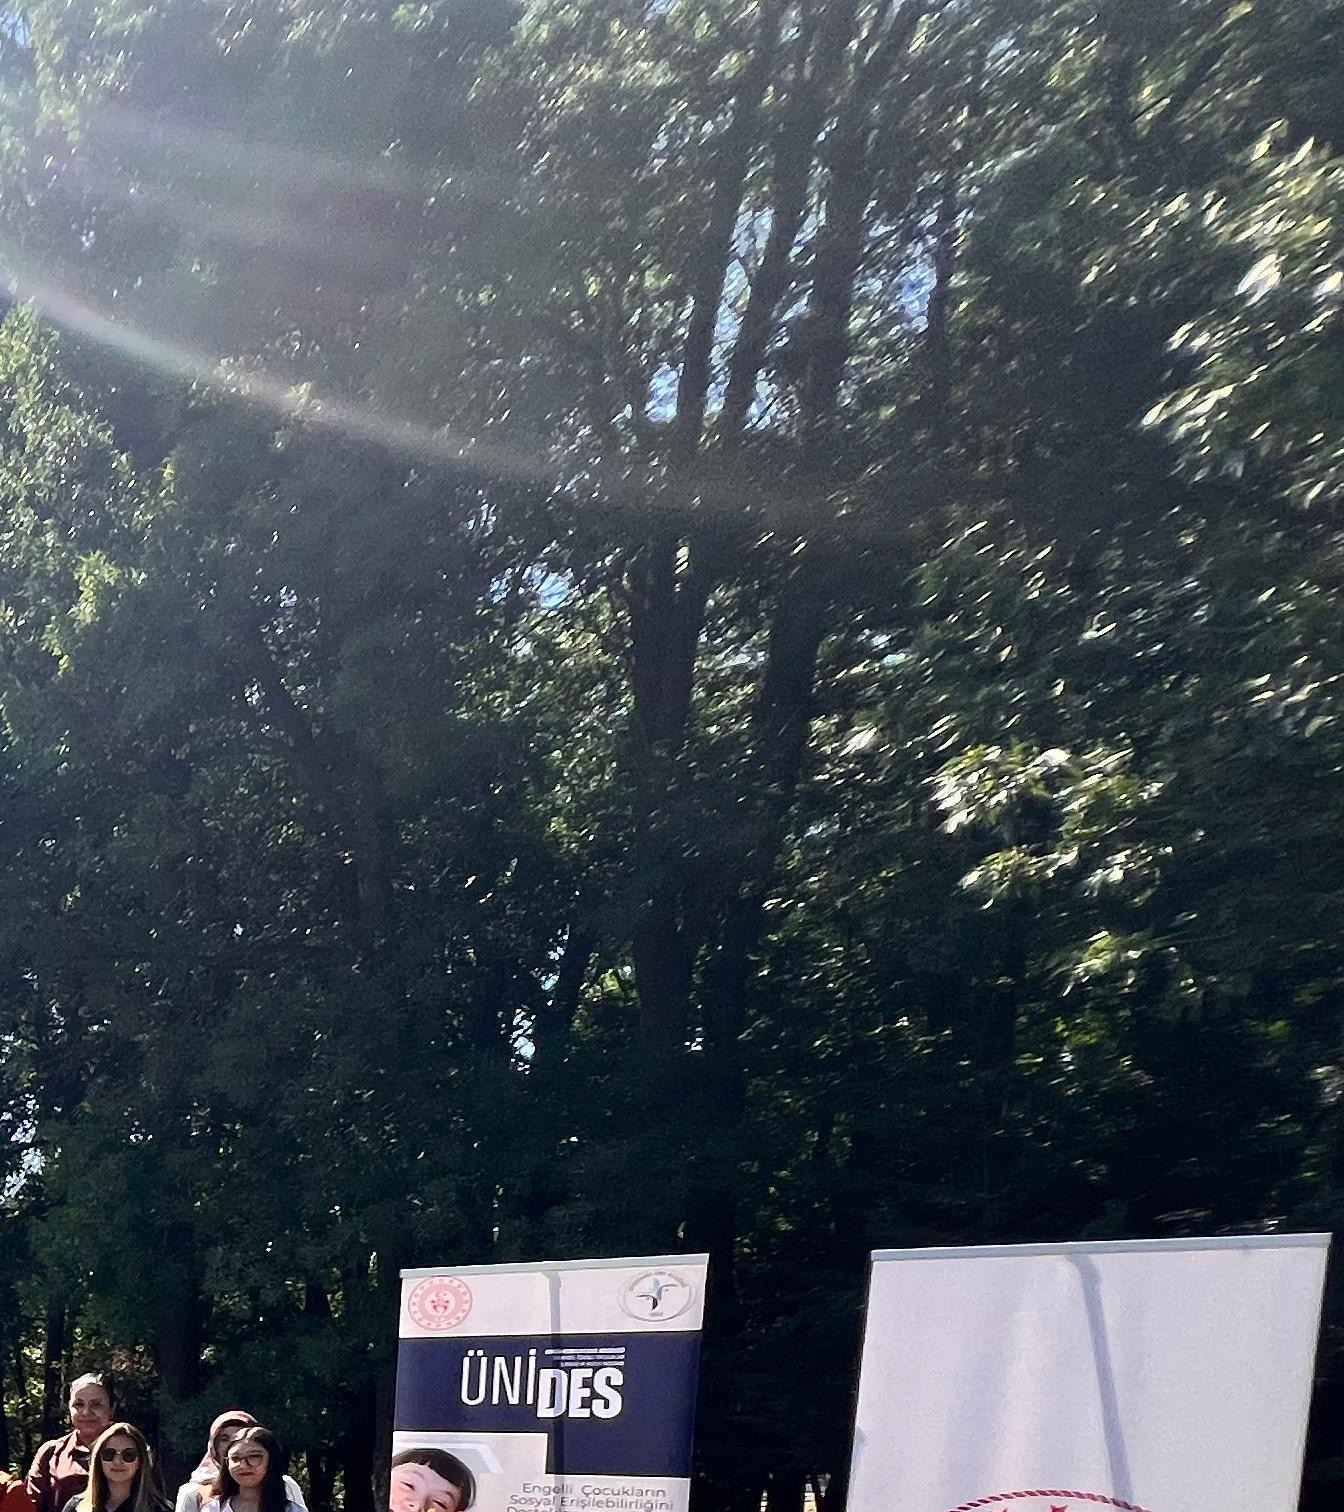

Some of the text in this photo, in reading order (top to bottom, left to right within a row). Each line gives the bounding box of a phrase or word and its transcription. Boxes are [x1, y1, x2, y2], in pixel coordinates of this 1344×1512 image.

[522, 1483, 666, 1498] Engelli Çocukların
[510, 1495, 556, 1507] Sosyal
